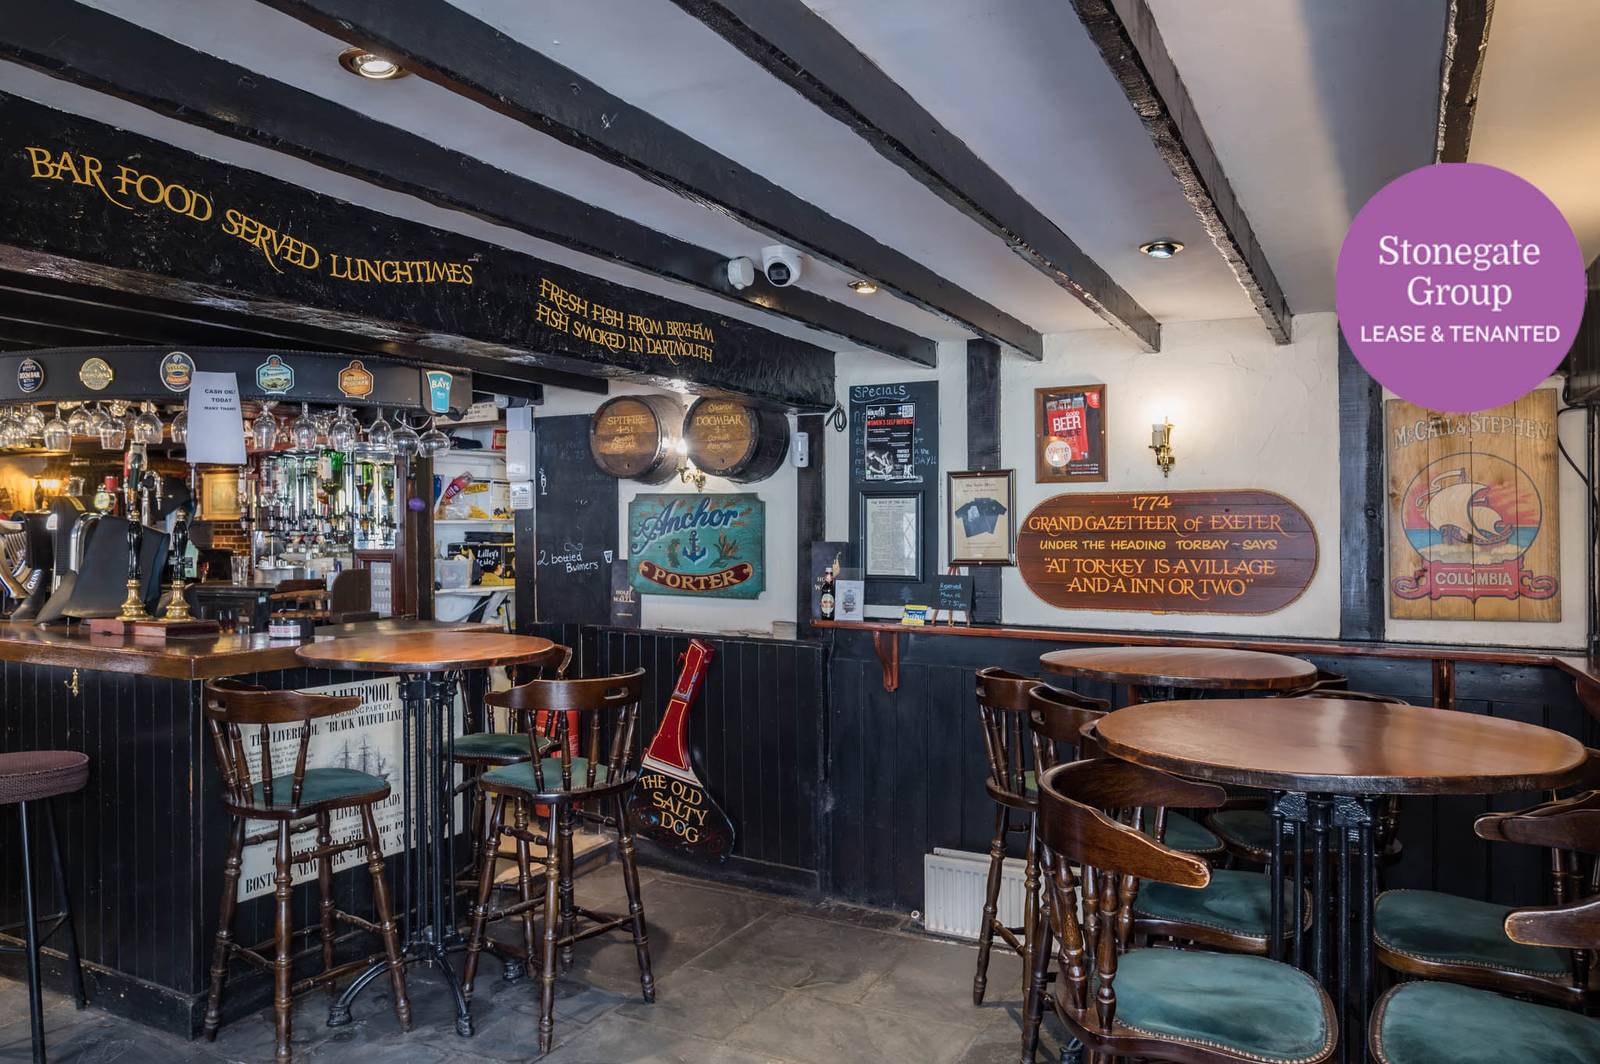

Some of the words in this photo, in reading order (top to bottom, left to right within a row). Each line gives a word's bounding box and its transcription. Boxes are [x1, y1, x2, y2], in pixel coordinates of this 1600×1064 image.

[25, 147, 133, 210] BAR
[112, 164, 213, 222] FOOD
[221, 208, 320, 274] SERVED
[329, 253, 473, 284] LUNCHTIMES
[538, 277, 589, 319] FRESH
[591, 303, 624, 330] FISH
[628, 314, 664, 338] FROM
[666, 320, 715, 344] BRIXHAM
[536, 302, 569, 333] FISH
[572, 321, 626, 353] SMOKED
[629, 335, 644, 353] IN
[647, 336, 713, 366] DARTMOUTH
[606, 414, 649, 426] SPITFIRE
[695, 414, 744, 427] DOOMBAR
[1053, 415, 1082, 432] BEER
[1456, 420, 1467, 436] &
[1132, 495, 1172, 511] 1774
[632, 496, 739, 556] Anchor
[1028, 516, 1083, 537] GRAND
[1085, 514, 1192, 538] GAZETTEER
[1184, 516, 1204, 532] of
[1208, 514, 1299, 538] EXETER
[1040, 540, 1078, 550] UNDER
[1082, 540, 1105, 550] THE
[1111, 540, 1167, 550] HEADING
[1176, 540, 1229, 550] TORBAY
[1242, 539, 1278, 550] SAYS
[537, 549, 550, 566] 2
[1154, 558, 1171, 574] IS
[1172, 558, 1189, 574] A
[1189, 558, 1278, 575] VILLAGE
[652, 567, 741, 591] PORTER
[1435, 570, 1513, 586] COLUMBIA
[1065, 577, 1111, 594] AND
[1111, 577, 1127, 593] A
[1130, 578, 1165, 594] INN
[1168, 578, 1210, 601] OR
[365, 704, 382, 713] PART
[383, 702, 392, 711] OF
[358, 713, 384, 728] WATCH
[639, 774, 667, 789] THE
[671, 781, 702, 805] OLD
[653, 791, 709, 826] SALTY
[661, 811, 699, 843] DOG
